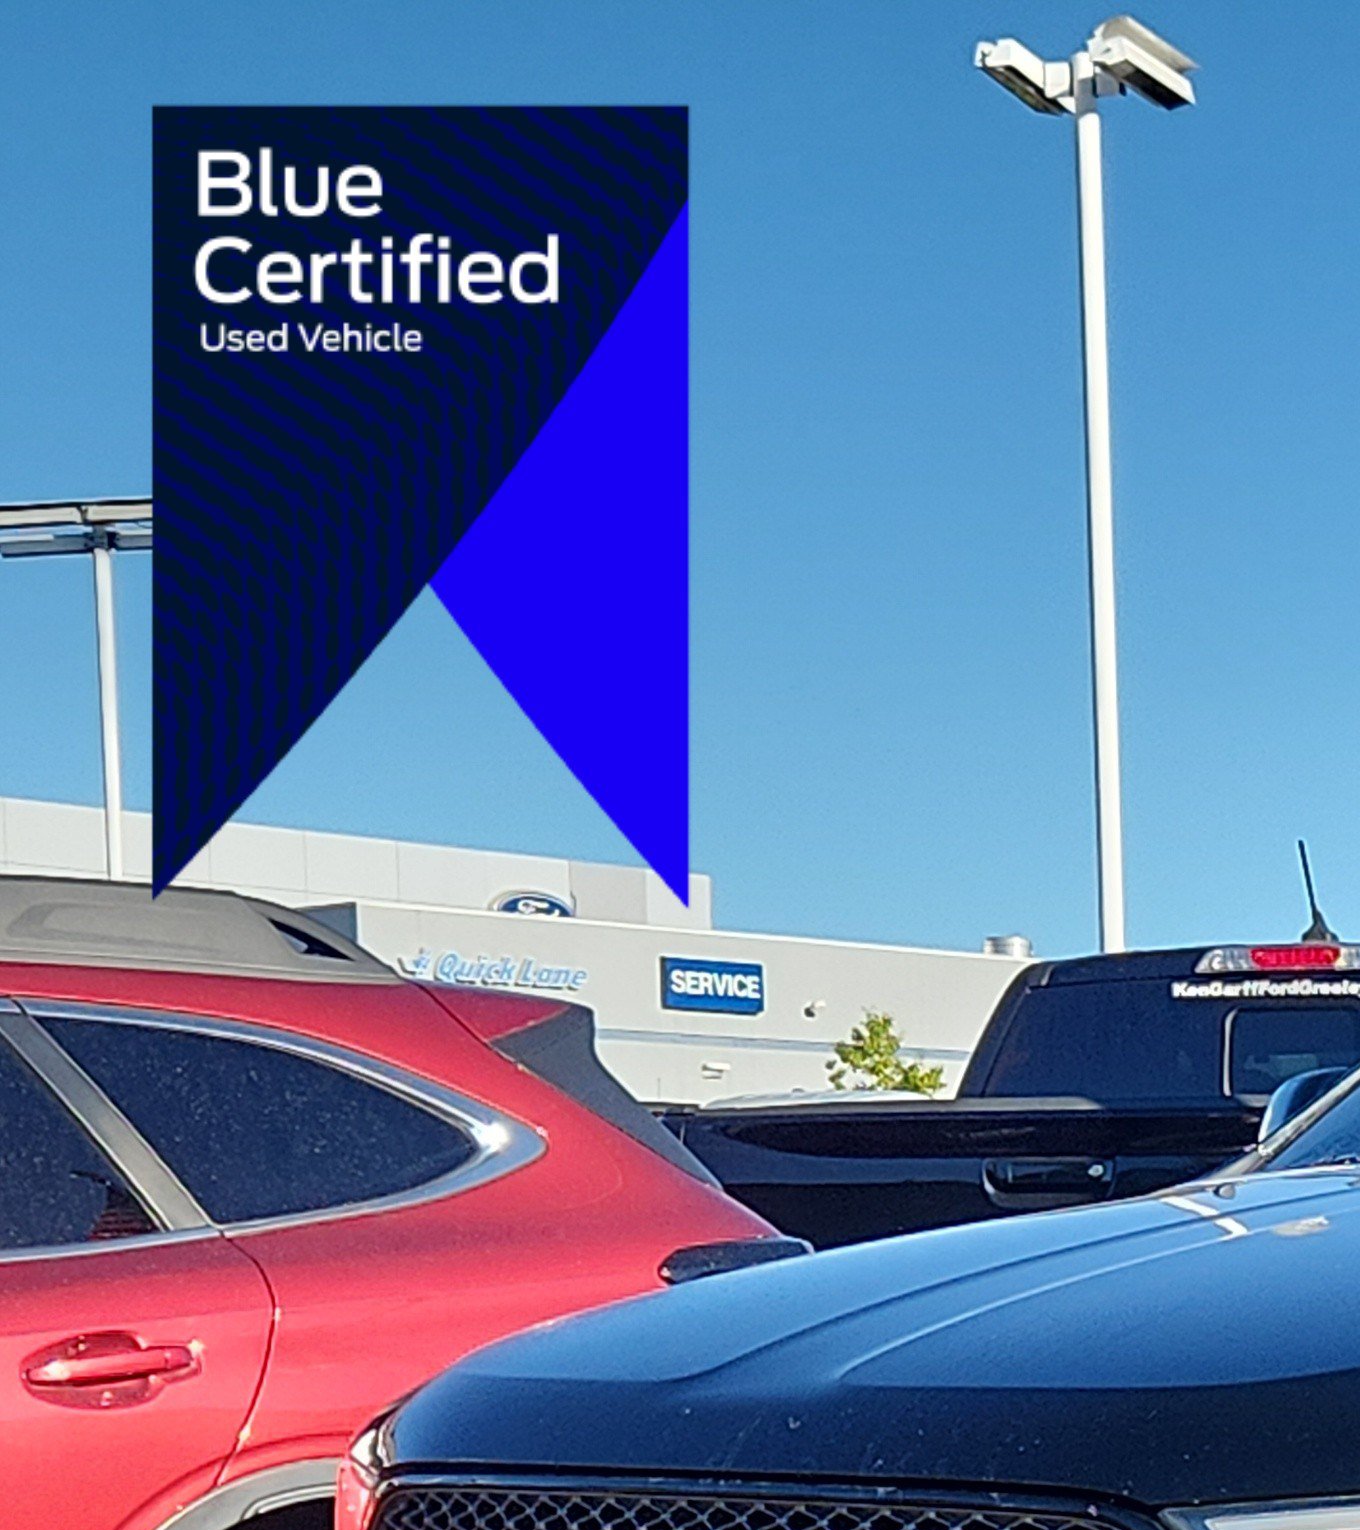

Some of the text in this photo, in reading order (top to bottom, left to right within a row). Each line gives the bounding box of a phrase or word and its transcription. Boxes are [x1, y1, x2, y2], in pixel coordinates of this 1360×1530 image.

[436, 953, 589, 990] Quick Lane
[671, 969, 761, 999] SERVICE
